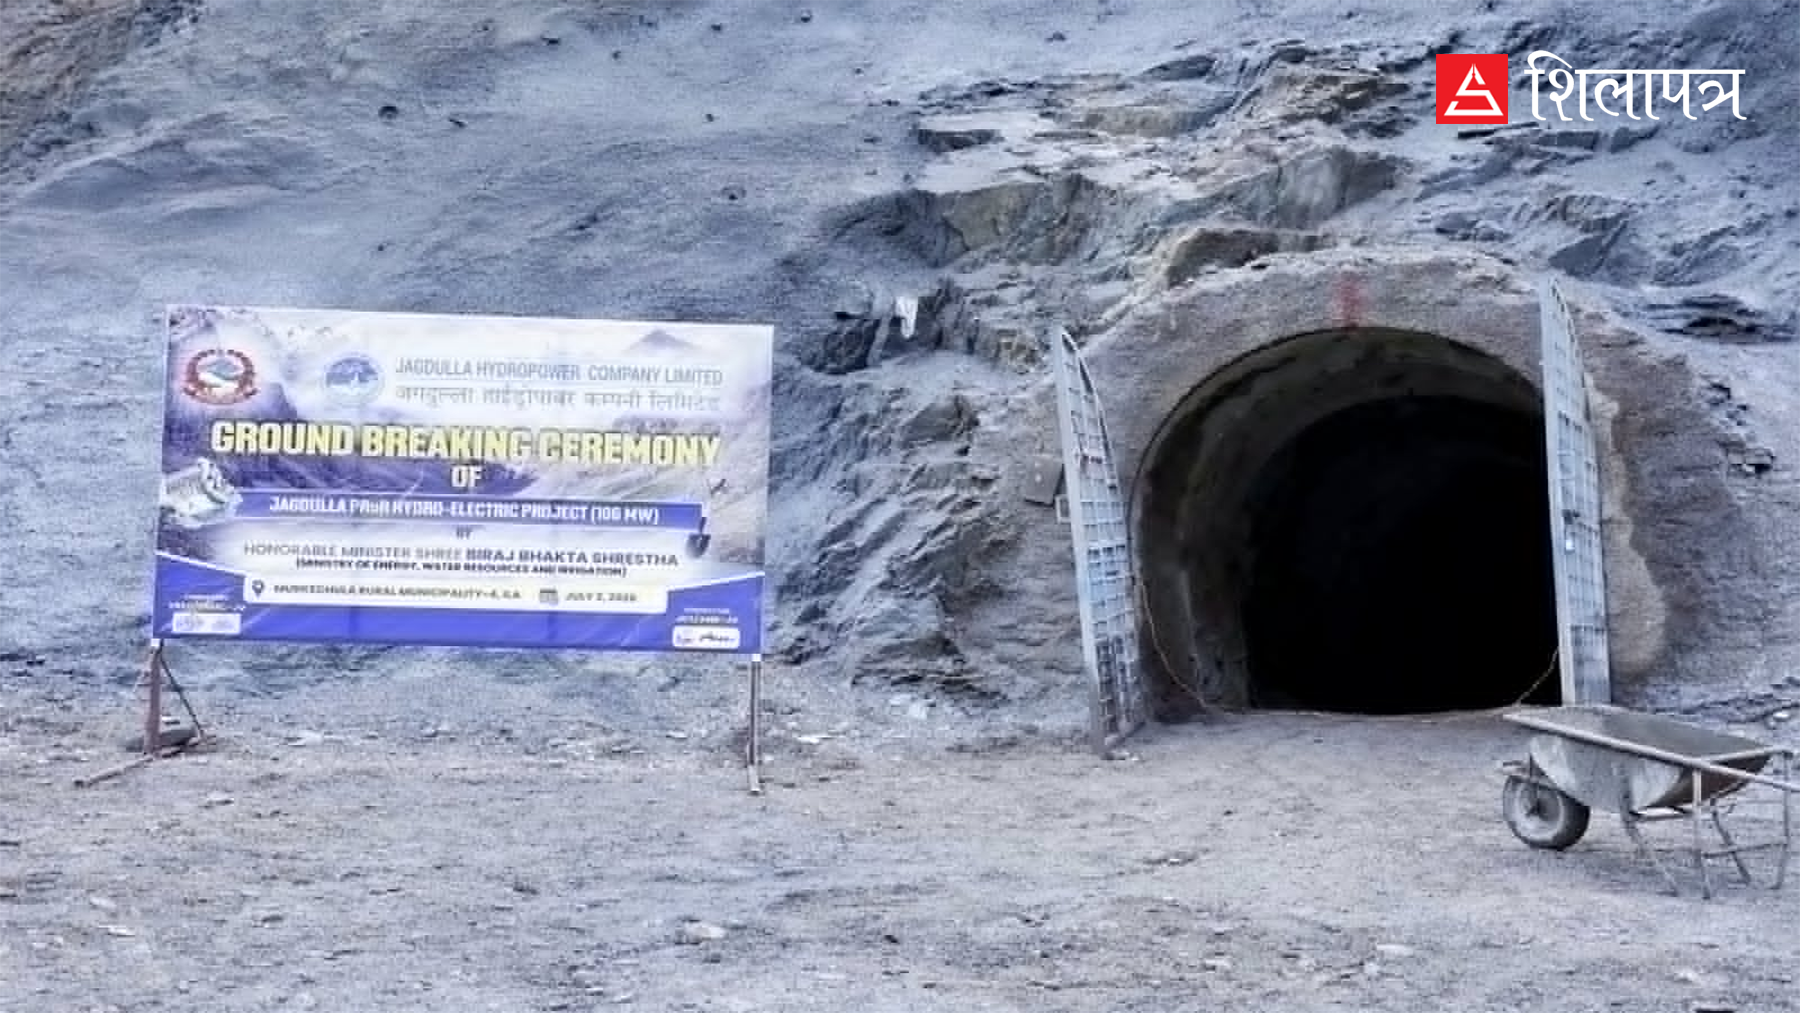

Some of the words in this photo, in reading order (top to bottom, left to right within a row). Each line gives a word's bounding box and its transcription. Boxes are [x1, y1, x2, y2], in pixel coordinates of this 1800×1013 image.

[396, 357, 472, 375] JAGDULLA
[477, 360, 580, 381] HYDROPOWER
[587, 365, 661, 383] COMPANY
[665, 367, 723, 386] LIMITED
[211, 420, 353, 456] GROUND
[361, 424, 532, 461] BREAKING
[540, 428, 721, 466] CEREMONY
[451, 465, 482, 488] OF
[269, 495, 345, 512] JAGDULLA
[521, 502, 588, 520] PROJECT
[624, 507, 659, 525] MW)
[244, 542, 336, 557] HONORABLE
[341, 546, 410, 558] MINISTER
[416, 547, 462, 559] SHREE
[466, 548, 514, 561] BIRAJ
[519, 550, 588, 564] BHAKTA
[593, 552, 679, 567] SHRESTHA
